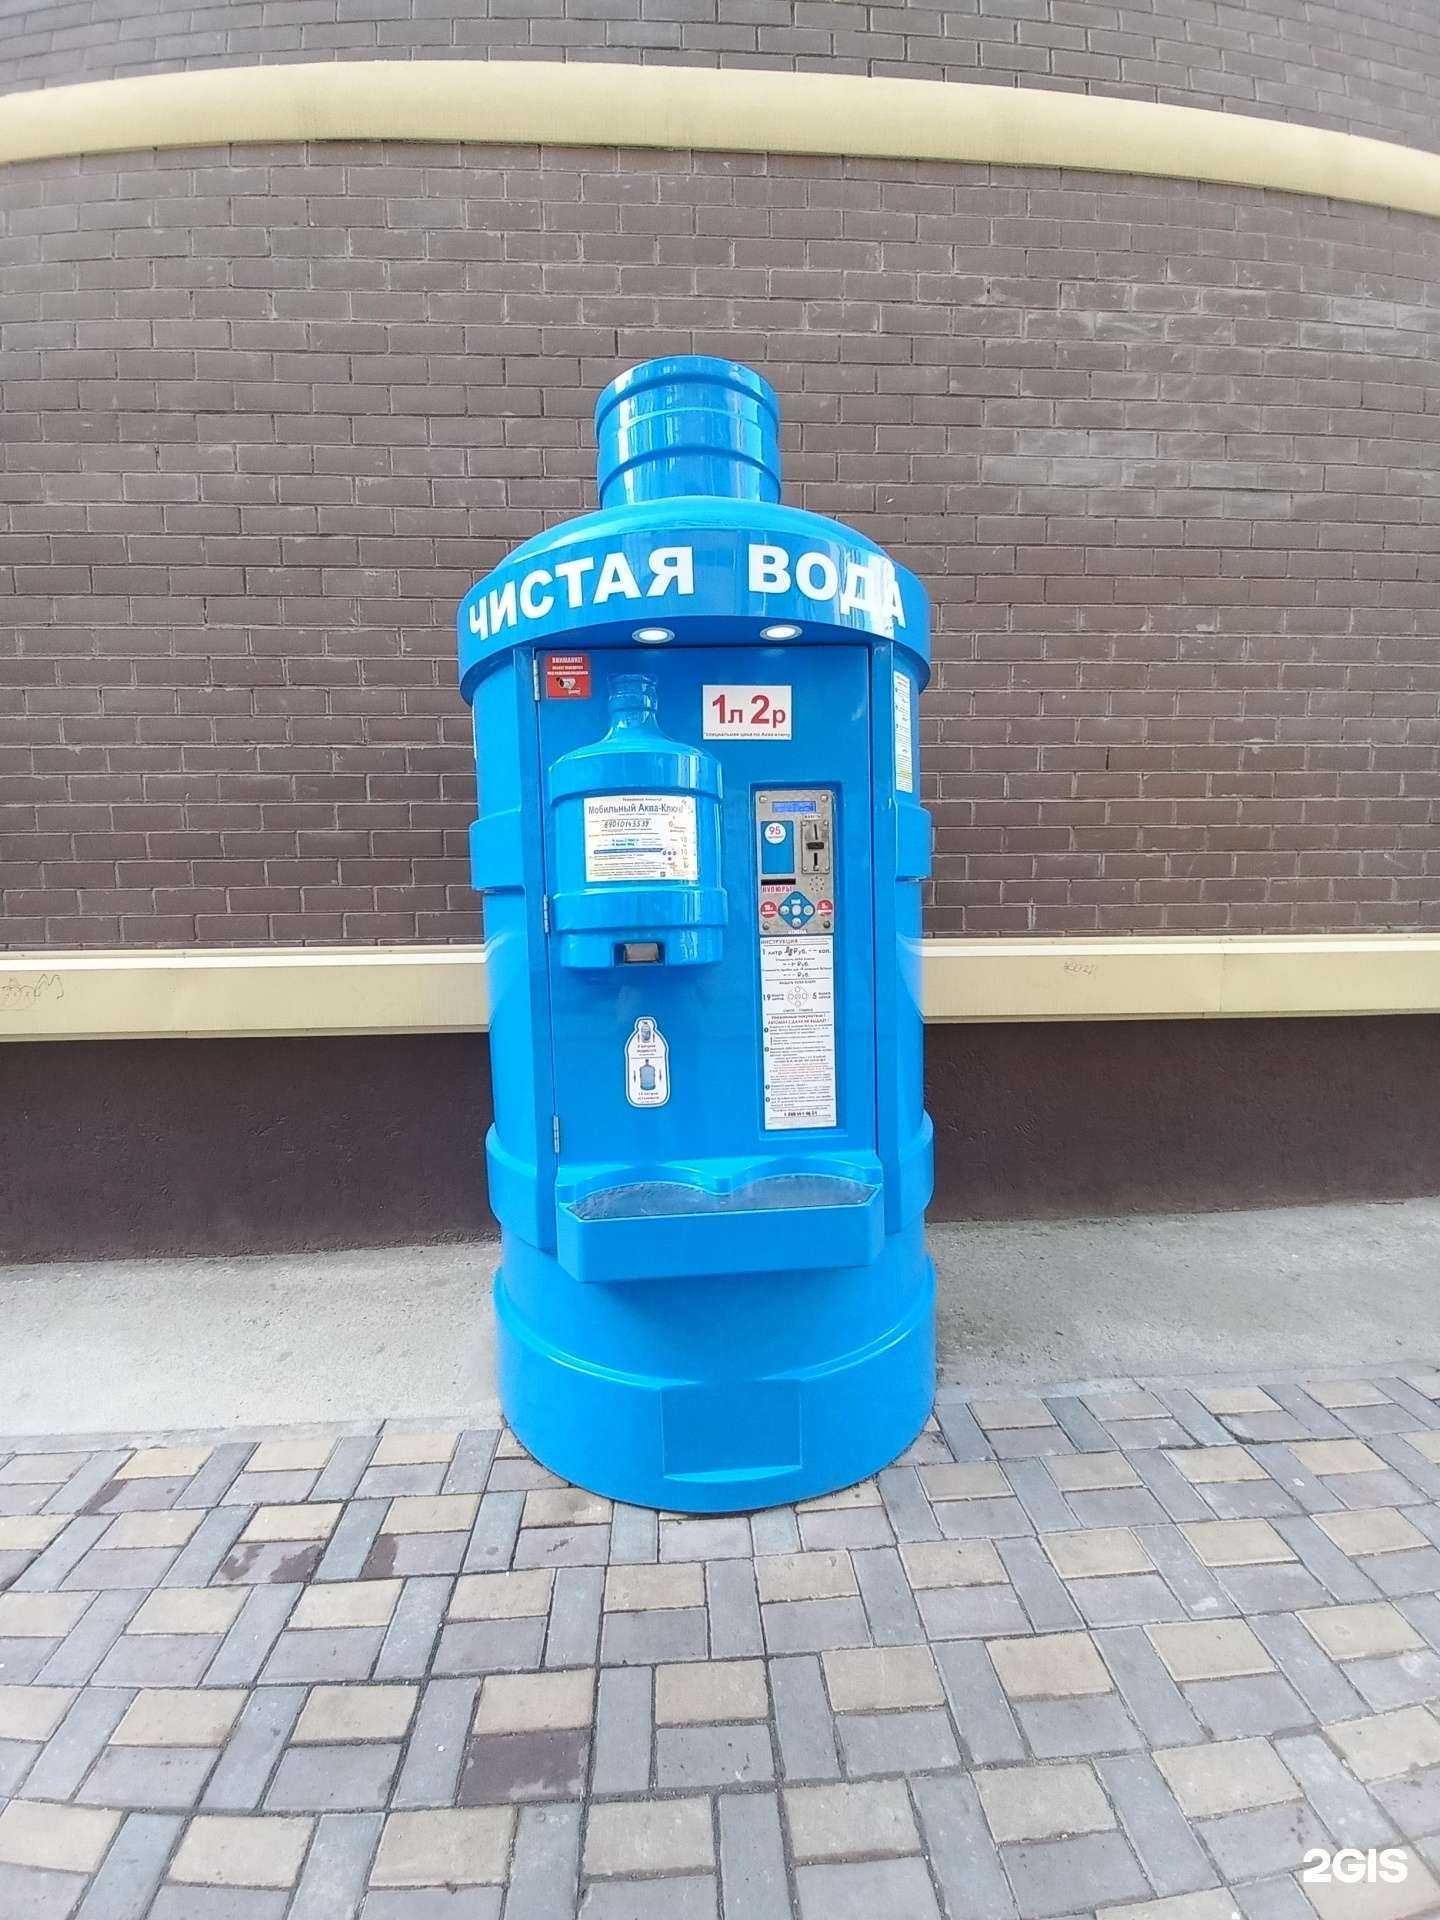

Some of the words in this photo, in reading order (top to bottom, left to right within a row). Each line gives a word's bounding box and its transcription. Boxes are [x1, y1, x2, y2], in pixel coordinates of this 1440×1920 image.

[469, 546, 694, 641] ЧИСТАЯ
[749, 543, 906, 629] ВОДА
[712, 694, 743, 724] 1л
[750, 694, 786, 728] 2р
[588, 803, 636, 815] Мобильный
[768, 826, 781, 835] 95
